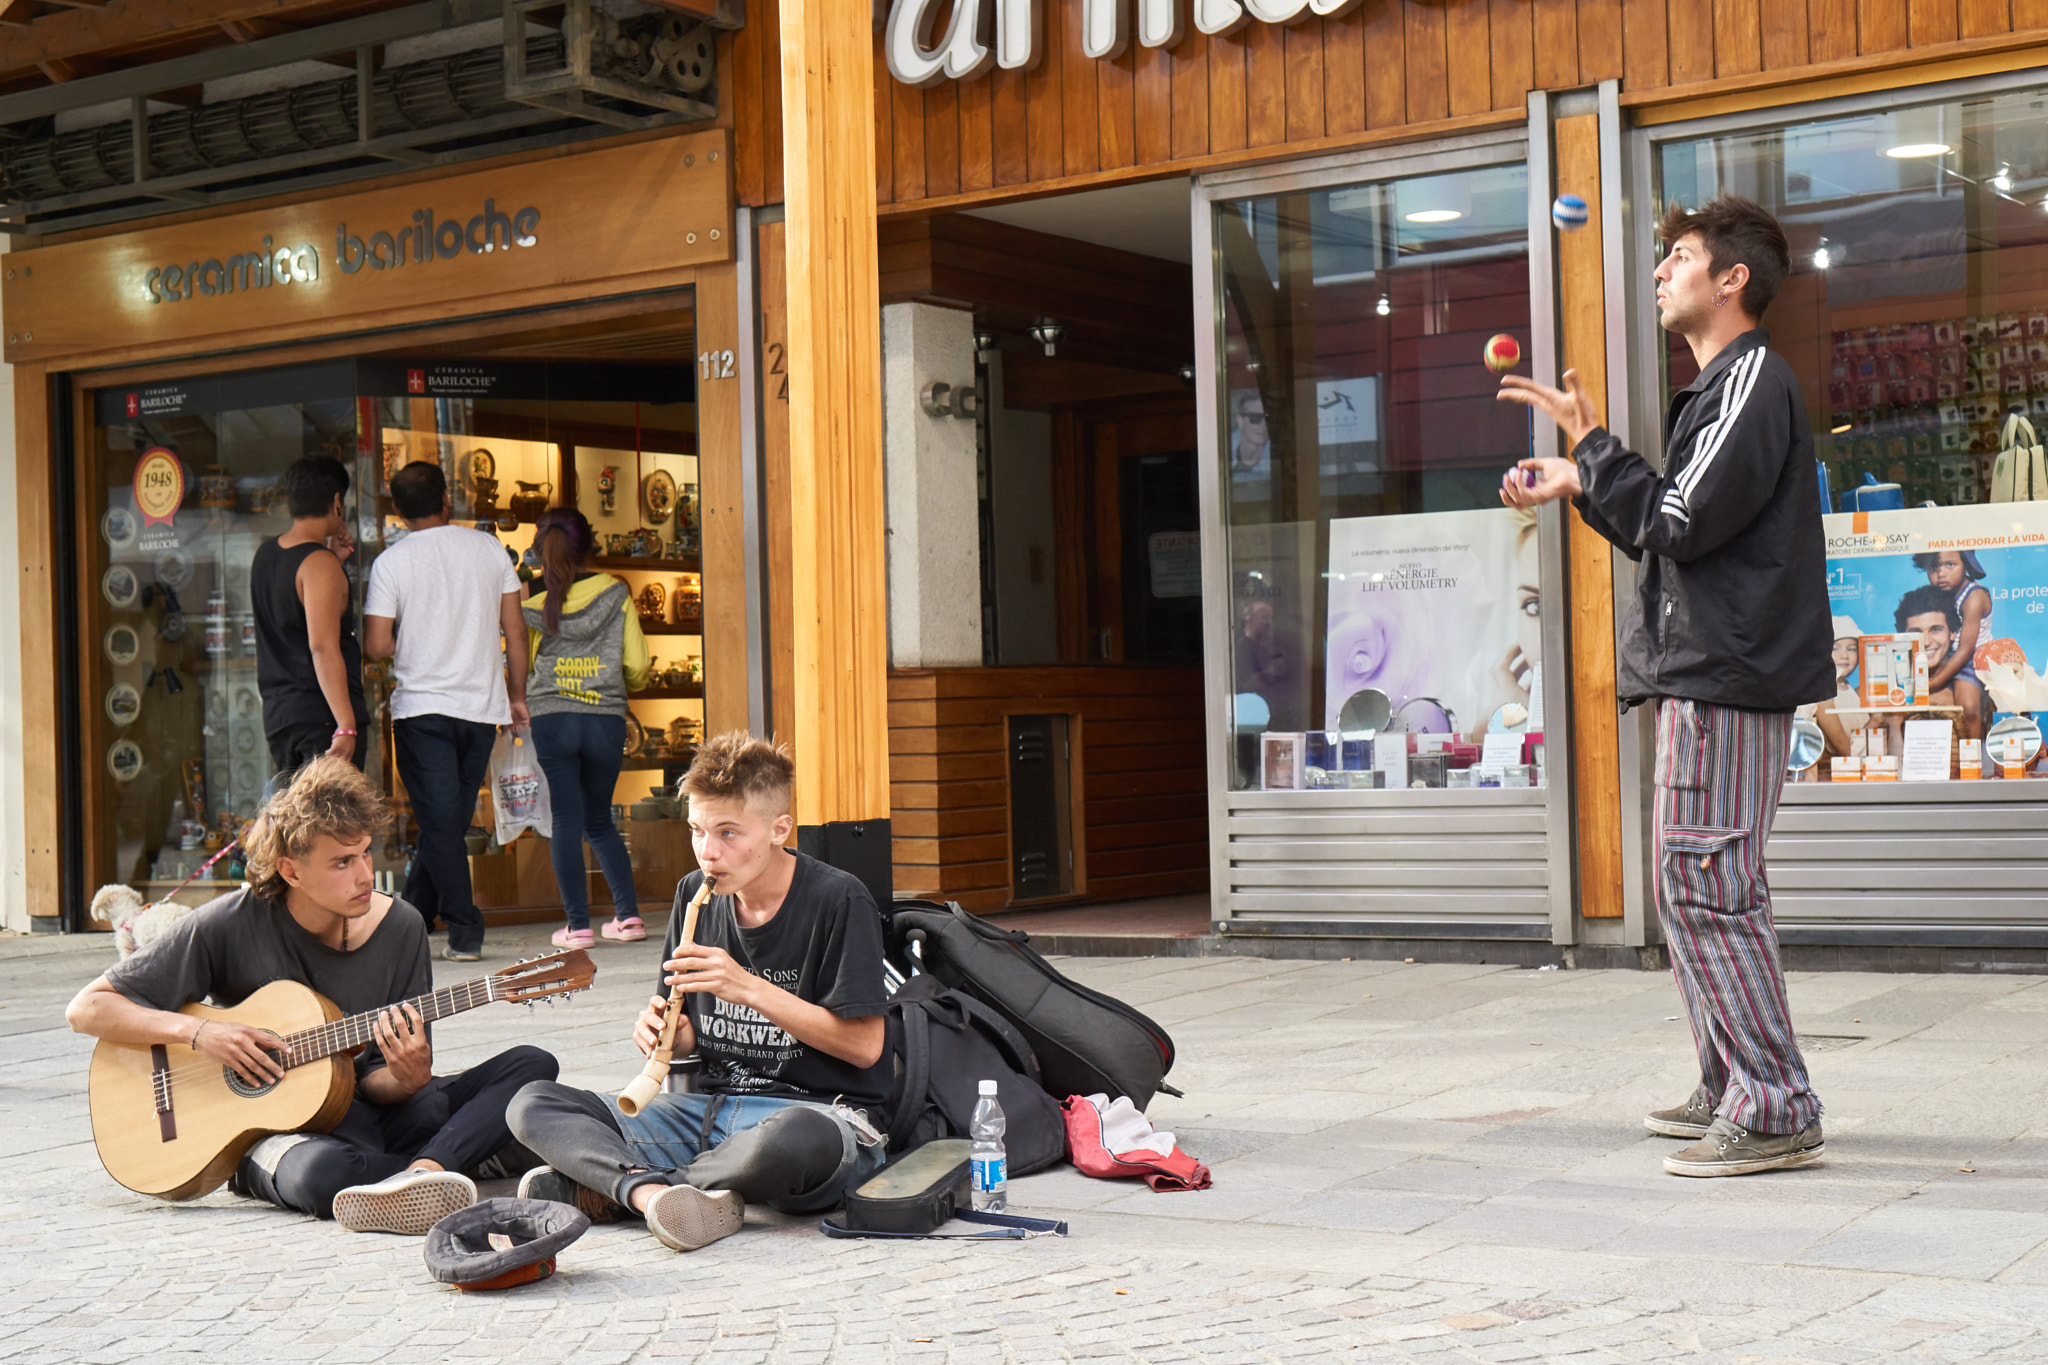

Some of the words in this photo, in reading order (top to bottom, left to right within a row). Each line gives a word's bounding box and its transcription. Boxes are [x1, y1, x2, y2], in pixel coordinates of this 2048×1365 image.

[143, 234, 319, 304] ceramica
[336, 199, 540, 274] bariloche
[699, 349, 735, 380] 112
[144, 471, 173, 488] 1948
[1928, 540, 1955, 549] PARA
[1956, 536, 2006, 547] MEJORAR
[2008, 535, 2020, 543] LA
[2022, 533, 2046, 543] VIDA
[1826, 548, 1852, 556] RATOIRE
[1362, 581, 1385, 592] LIFT
[1389, 578, 1458, 591] VOLUMETRY
[1992, 586, 2009, 600] La
[2026, 600, 2045, 614] de
[555, 656, 600, 677] SORRY
[556, 677, 583, 690] NOT
[747, 1049, 774, 1059] BRAND
